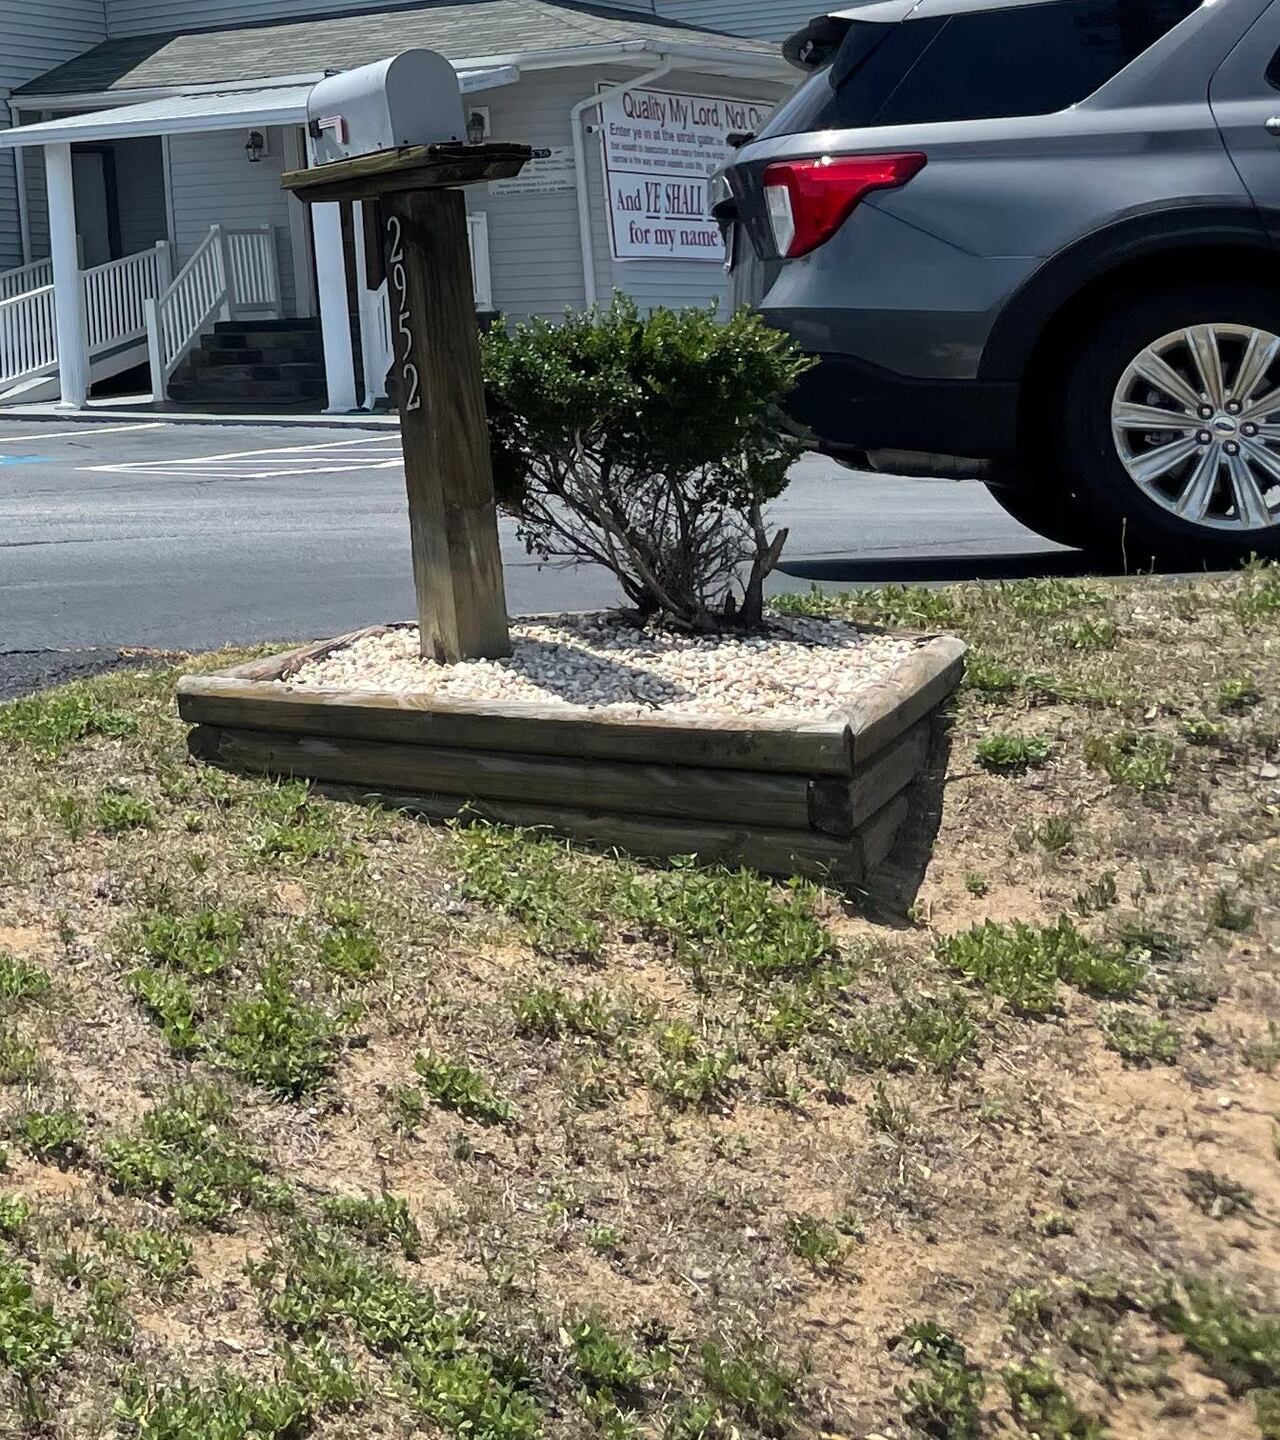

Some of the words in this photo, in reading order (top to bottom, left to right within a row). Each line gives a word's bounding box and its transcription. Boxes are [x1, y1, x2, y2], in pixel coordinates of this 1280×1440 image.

[622, 92, 666, 128] Quality
[669, 97, 688, 129] My
[691, 100, 723, 130] Lord,
[725, 104, 746, 129] Not
[610, 122, 631, 138] Enter
[662, 128, 675, 142] the
[617, 188, 642, 212] And
[645, 181, 661, 213] YE
[665, 183, 704, 215] SHALL
[629, 220, 651, 244] for
[655, 228, 676, 252] my
[680, 230, 718, 247] name
[386, 215, 421, 411] 2952
